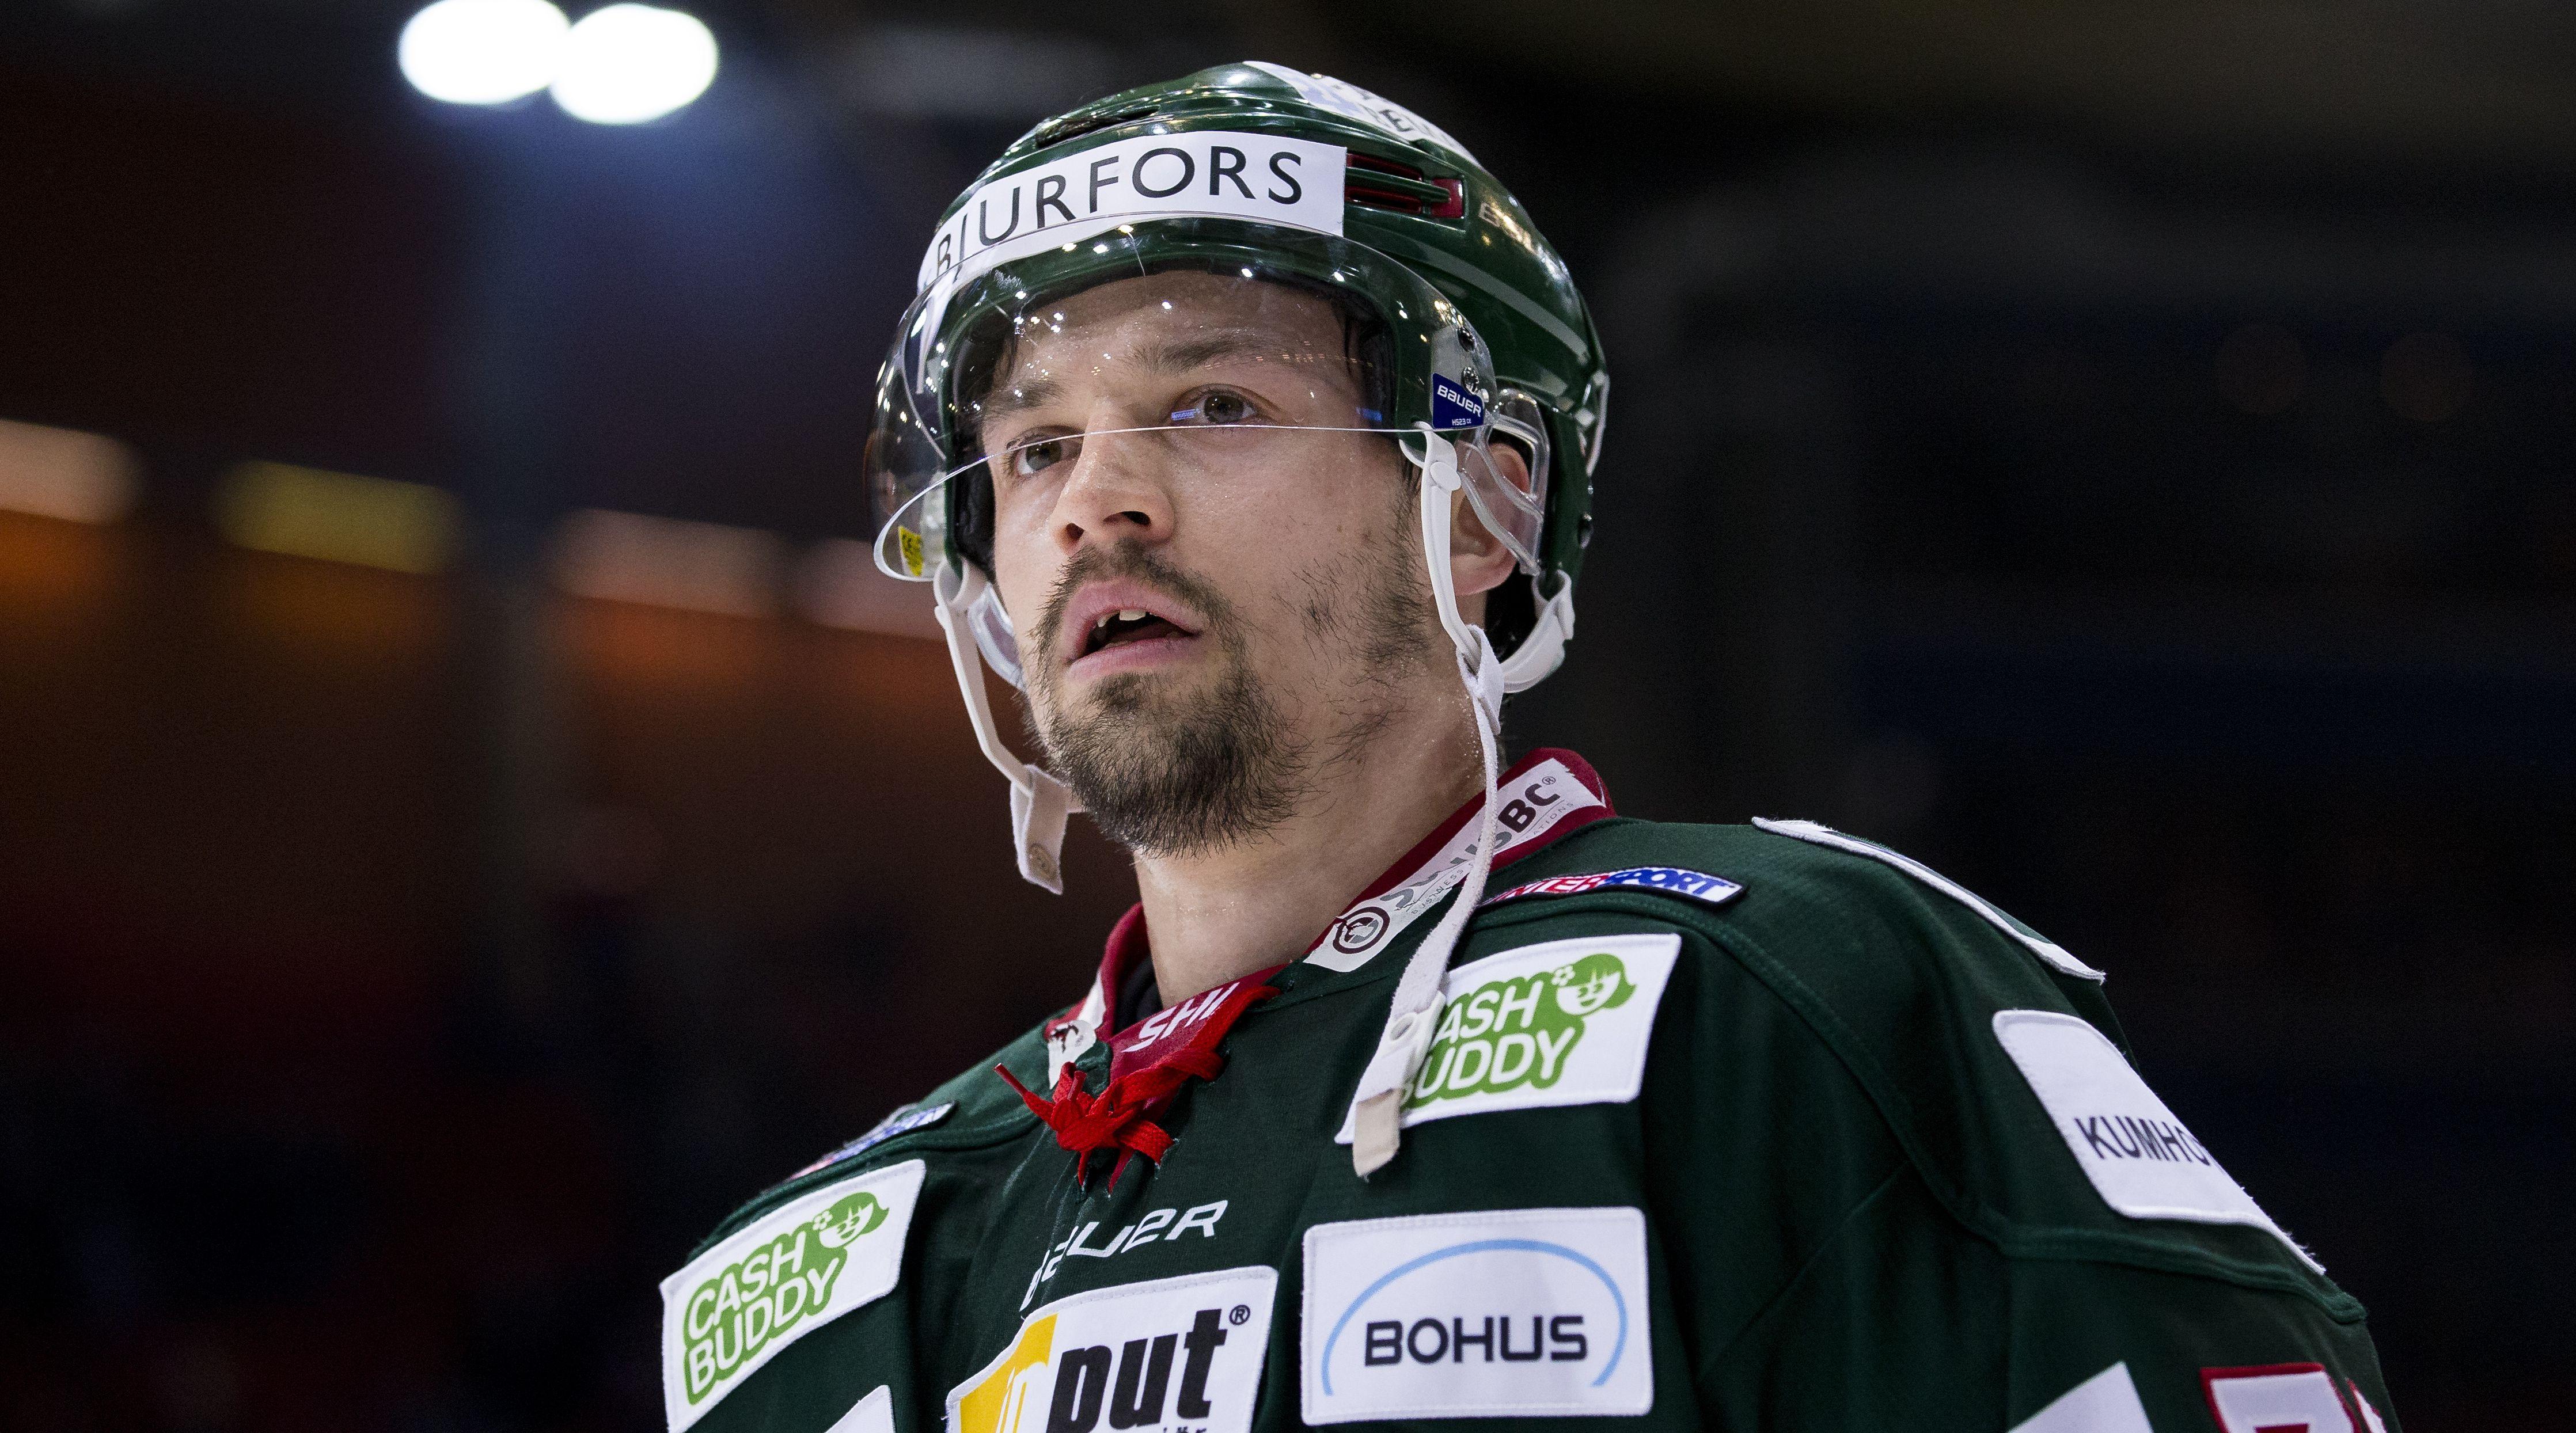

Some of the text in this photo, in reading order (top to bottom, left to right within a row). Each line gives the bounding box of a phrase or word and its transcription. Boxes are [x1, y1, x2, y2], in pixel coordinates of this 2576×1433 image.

[936, 145, 1303, 284] BJURFORS
[1430, 980, 1545, 1048] ASH
[688, 1231, 806, 1339] CASH
[689, 1257, 840, 1394] BUDDY
[1364, 1315, 1588, 1367] BOHUS
